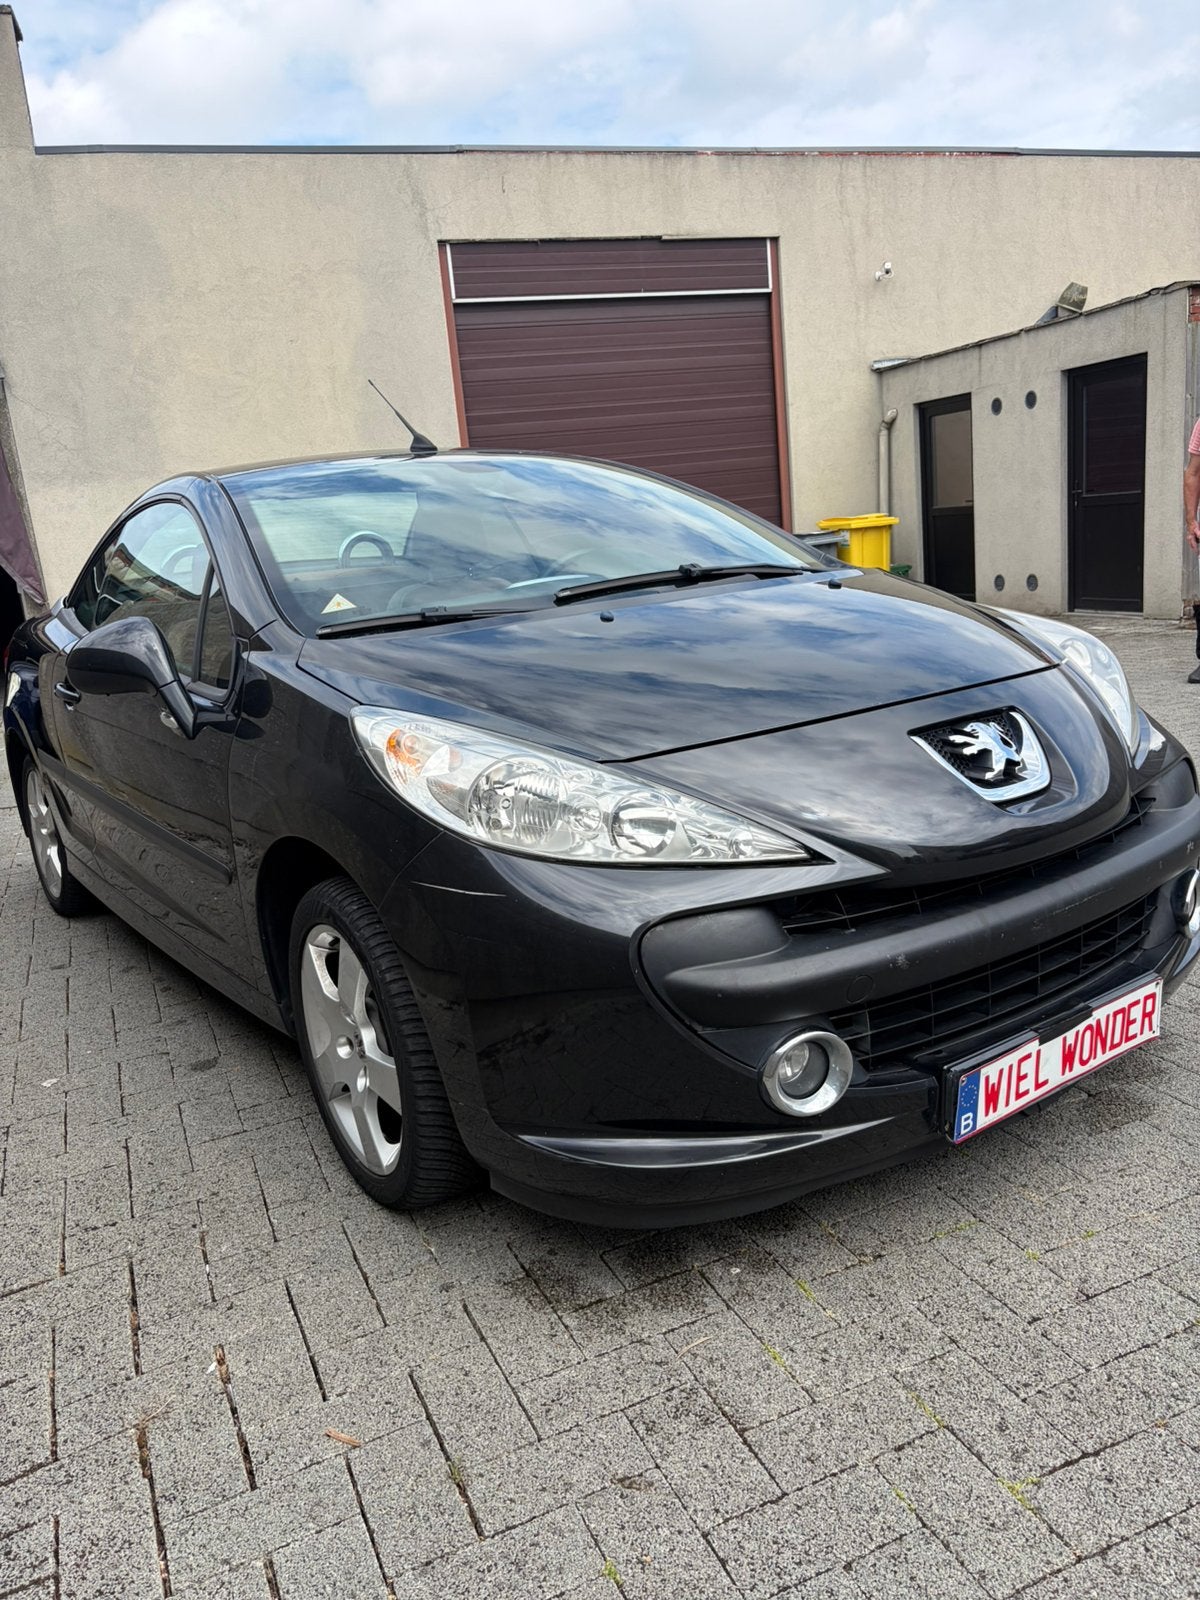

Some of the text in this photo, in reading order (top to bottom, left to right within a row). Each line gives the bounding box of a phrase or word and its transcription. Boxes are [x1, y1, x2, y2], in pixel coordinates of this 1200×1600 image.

[984, 992, 1157, 1117] WIEL WONDER
[960, 1112, 974, 1135] B
